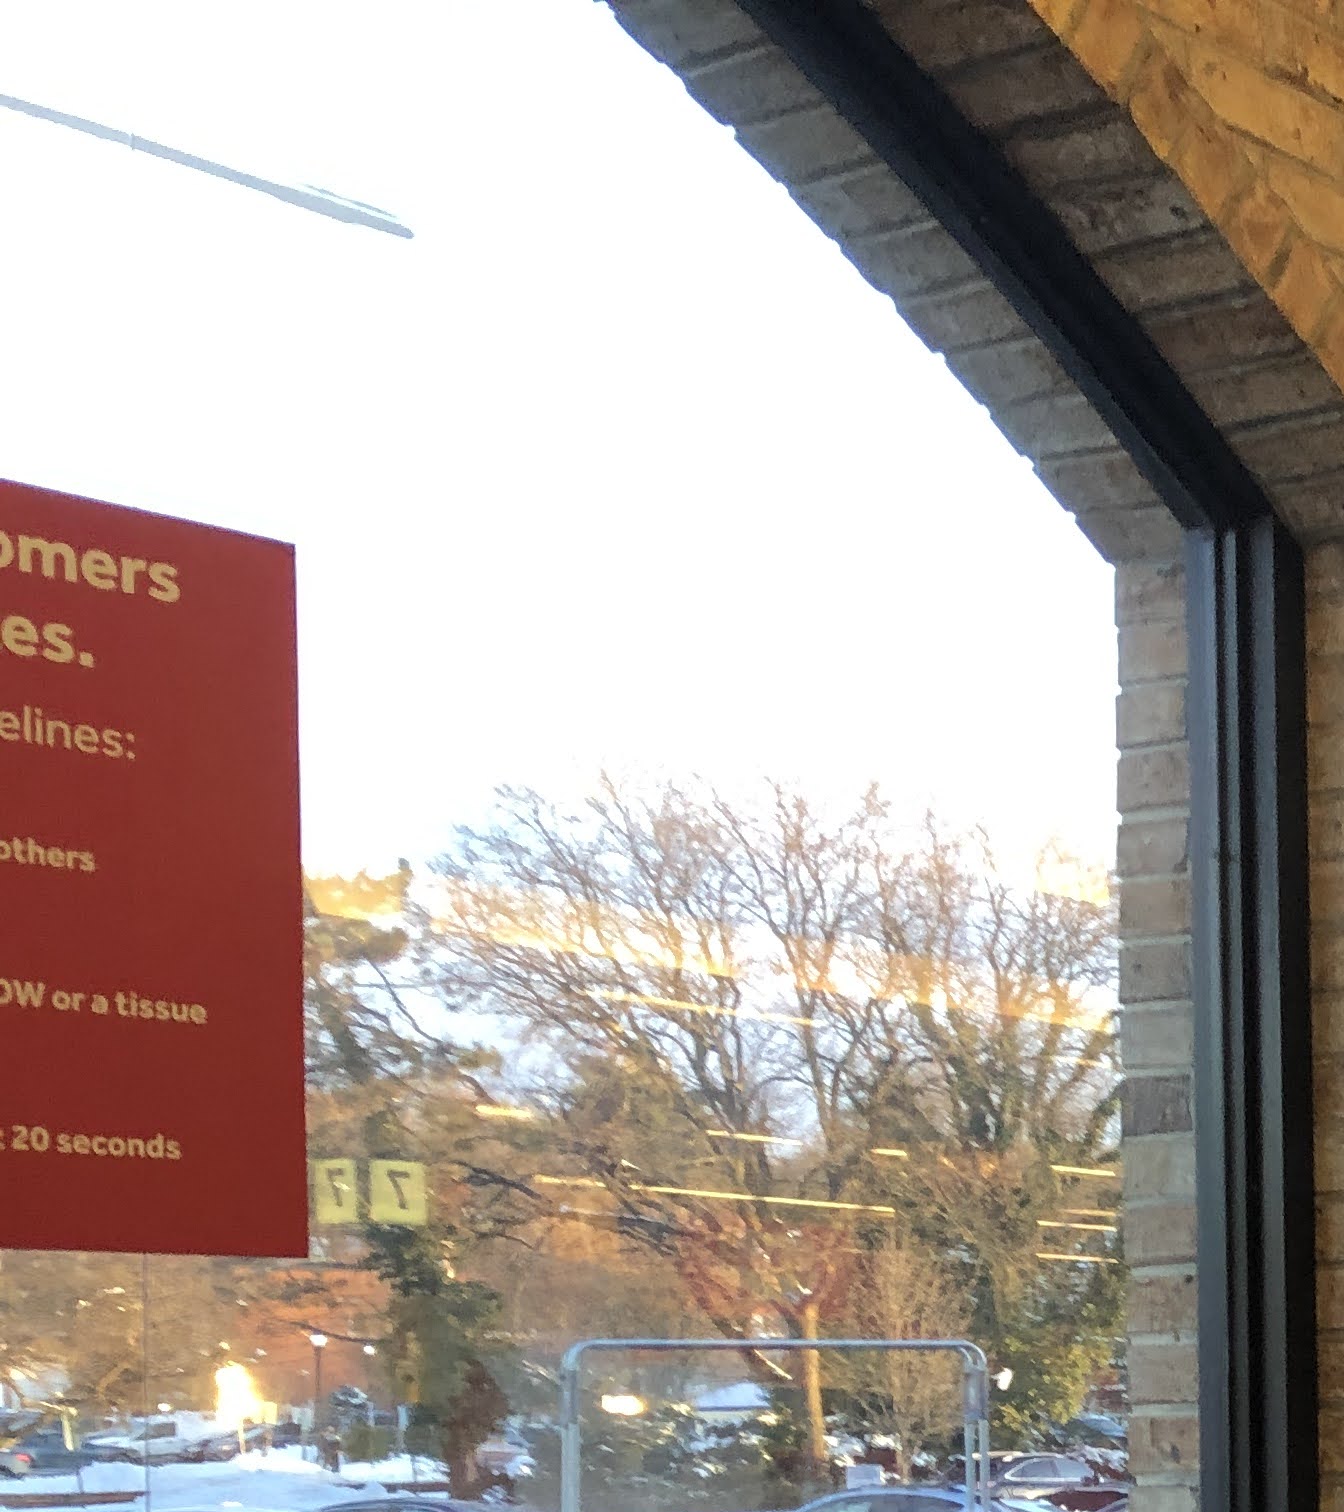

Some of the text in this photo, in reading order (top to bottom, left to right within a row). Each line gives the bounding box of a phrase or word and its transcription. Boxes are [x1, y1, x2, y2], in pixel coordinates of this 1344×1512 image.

[52, 988, 85, 1011] or
[91, 994, 109, 1015] a
[115, 991, 208, 1024] tissue
[12, 1124, 183, 1161] 20 seconds
